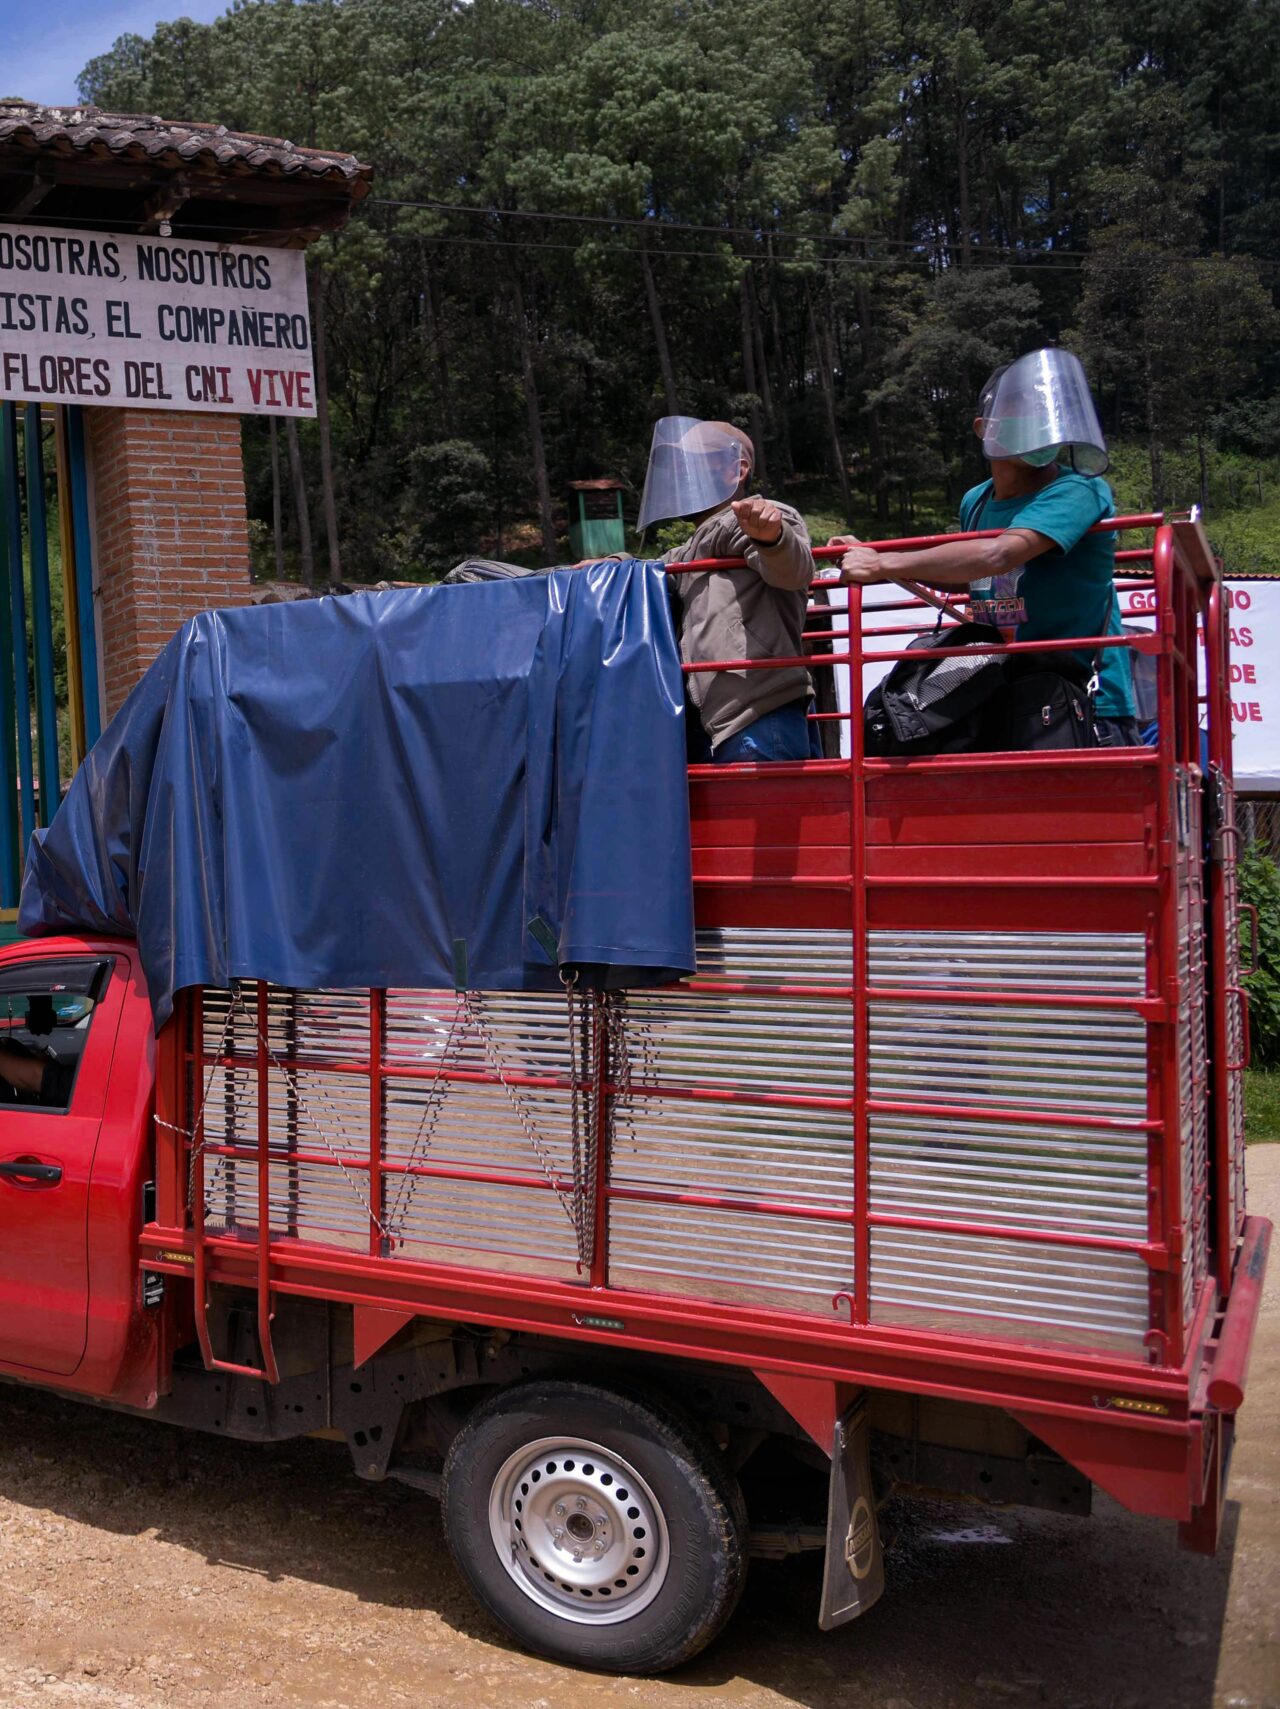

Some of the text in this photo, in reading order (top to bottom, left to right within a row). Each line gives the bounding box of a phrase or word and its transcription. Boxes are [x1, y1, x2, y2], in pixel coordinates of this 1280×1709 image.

[137, 245, 272, 290] NOSOTROS
[106, 300, 141, 339] EL
[158, 304, 308, 350] COMPAÑERO
[3, 353, 111, 397] FLORES
[124, 361, 172, 400] DEL
[185, 364, 233, 404] CNI
[246, 368, 312, 408] VIVE
